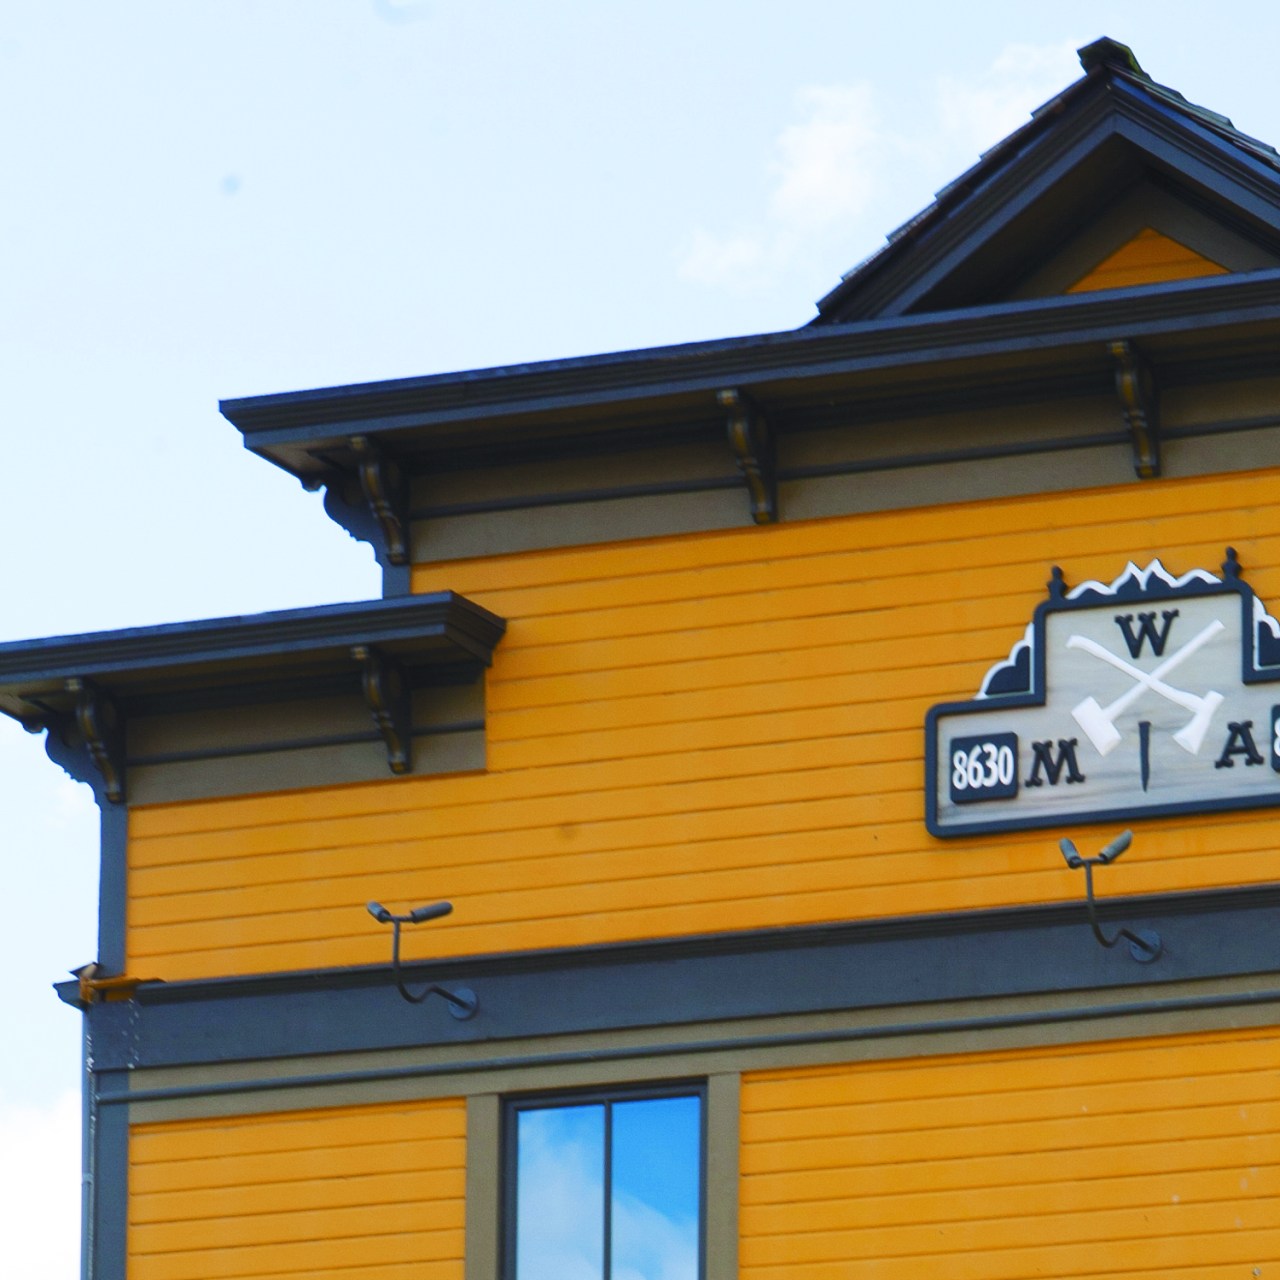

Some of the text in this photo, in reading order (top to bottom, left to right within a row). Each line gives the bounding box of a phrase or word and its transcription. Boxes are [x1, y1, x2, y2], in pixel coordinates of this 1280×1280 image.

[1115, 608, 1179, 659] W
[951, 742, 1014, 791] 8630
[1025, 737, 1085, 788] M
[1215, 720, 1264, 768] A
